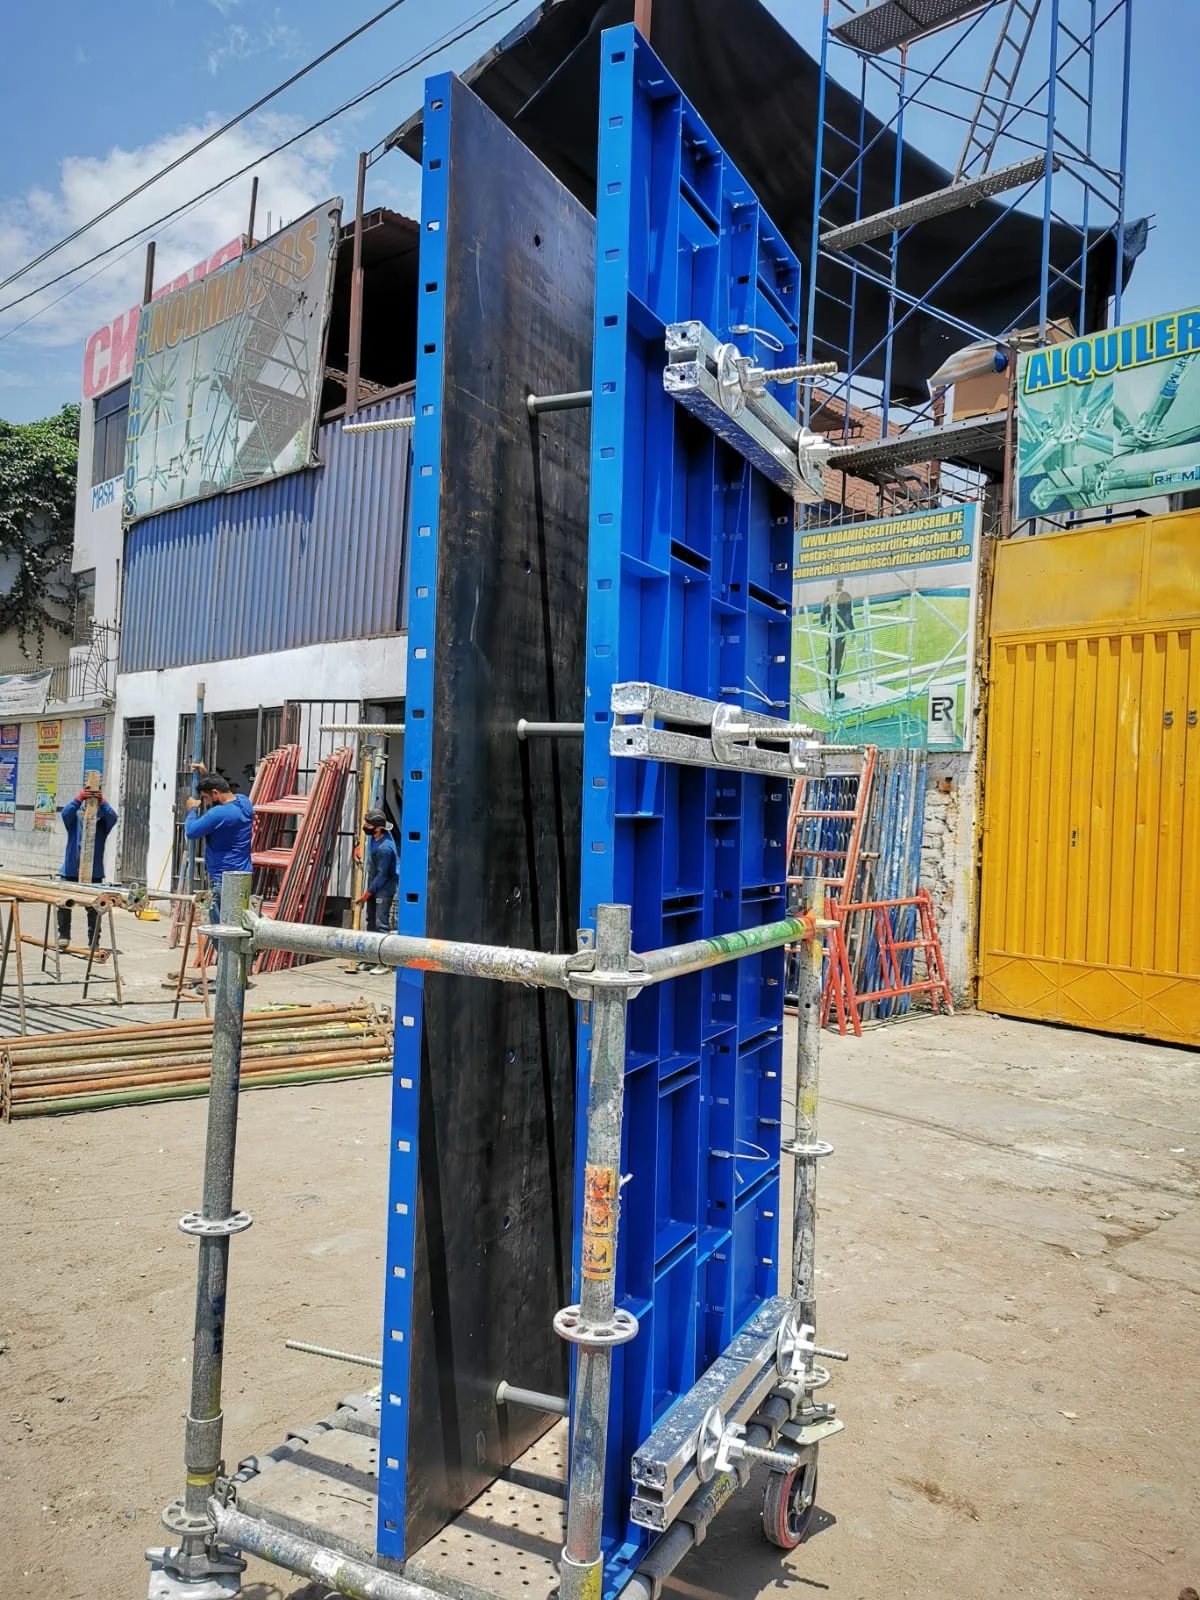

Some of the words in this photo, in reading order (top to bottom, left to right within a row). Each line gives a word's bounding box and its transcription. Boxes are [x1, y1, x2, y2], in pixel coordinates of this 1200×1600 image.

[1026, 308, 1200, 392] ALQUILER
[123, 310, 150, 516] ANDAMIOS
[931, 696, 954, 722] ER
